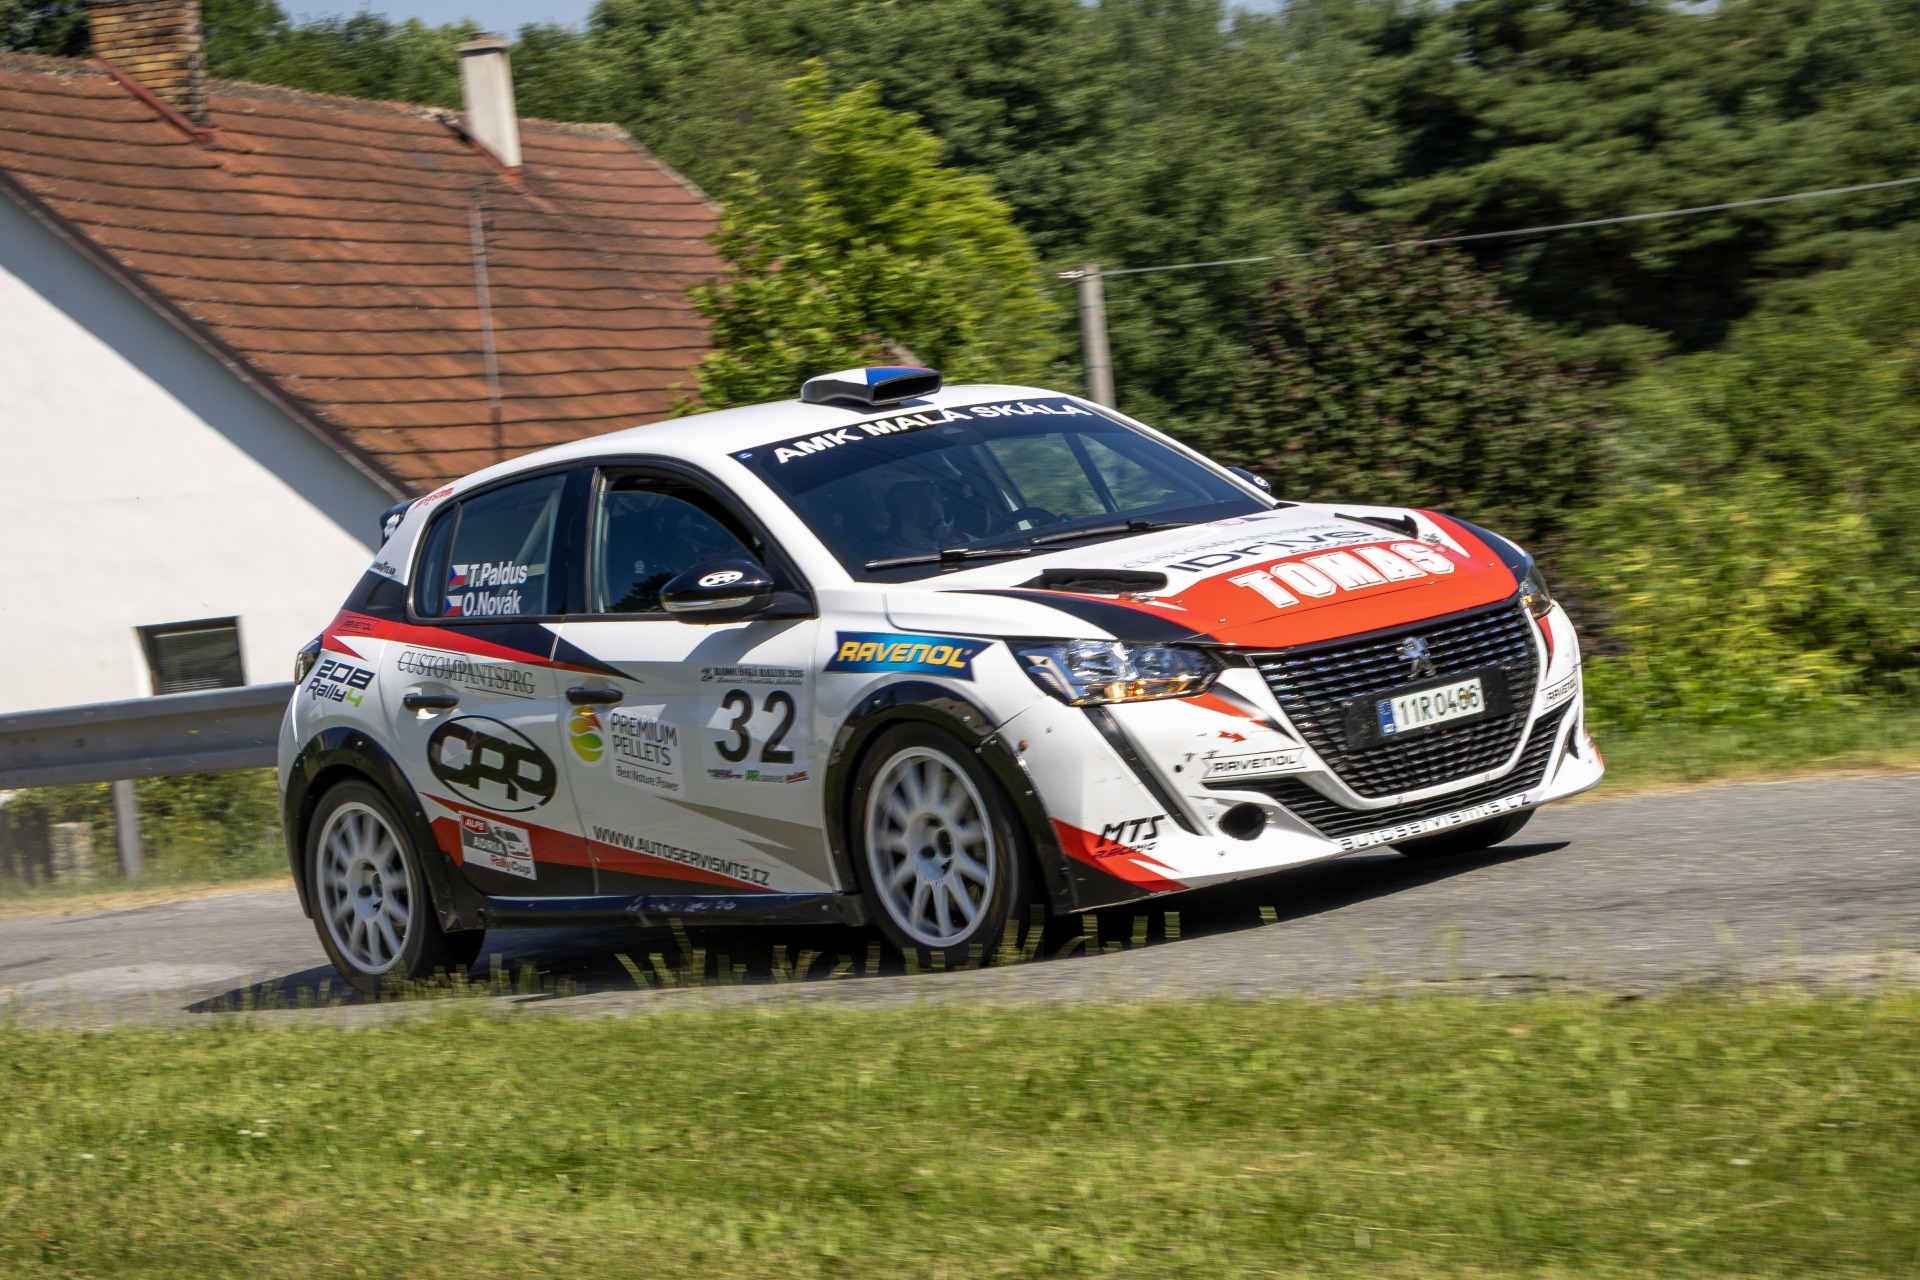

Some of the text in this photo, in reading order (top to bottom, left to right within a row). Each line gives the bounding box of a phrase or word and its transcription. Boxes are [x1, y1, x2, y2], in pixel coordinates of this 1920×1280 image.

[774, 401, 1093, 464] AMK MALÁ SKÁLA
[468, 561, 528, 588] T.Paldus
[1227, 543, 1456, 610] TOMAS
[462, 589, 522, 617] O.Novák
[836, 641, 968, 669] RAVENOL
[315, 659, 376, 691] 208
[610, 712, 678, 747] PREMIUM
[713, 688, 797, 765] 32
[612, 734, 672, 766] PELLETS
[1213, 755, 1297, 772] RAVENOL
[1097, 813, 1169, 848] MTS
